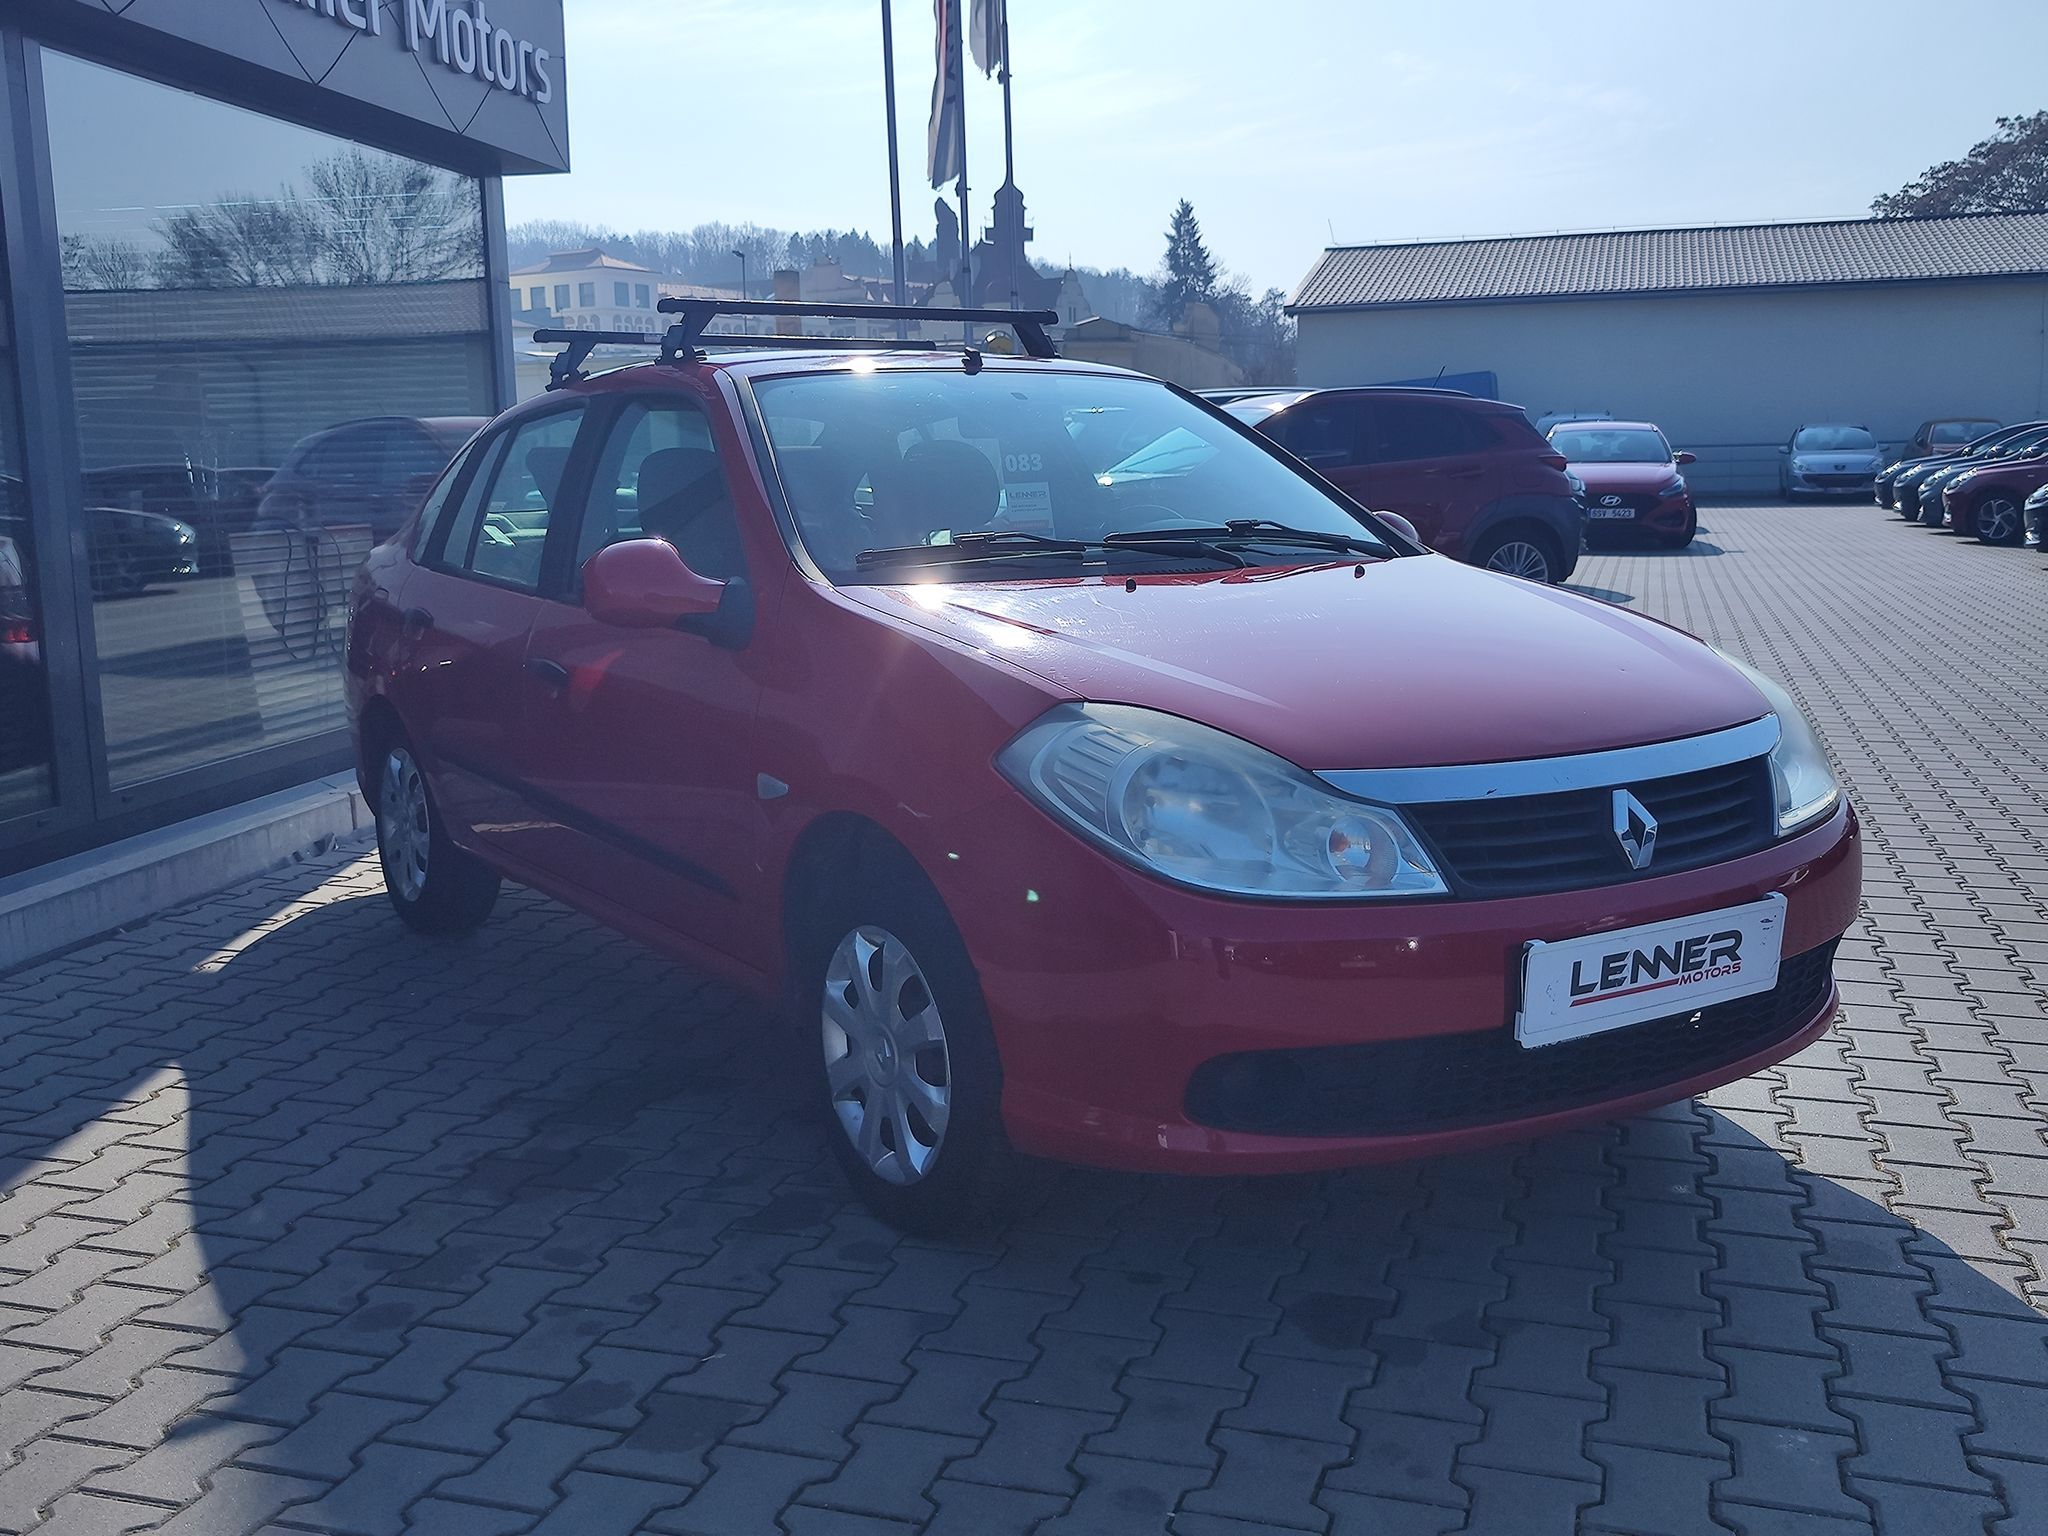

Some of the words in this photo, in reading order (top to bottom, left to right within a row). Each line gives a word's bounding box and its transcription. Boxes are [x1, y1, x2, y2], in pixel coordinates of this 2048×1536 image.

[405, 0, 551, 104] Motors
[1006, 453, 1043, 472] 083
[1571, 930, 1742, 996] LENNER
[1678, 961, 1742, 986] MOTORS
